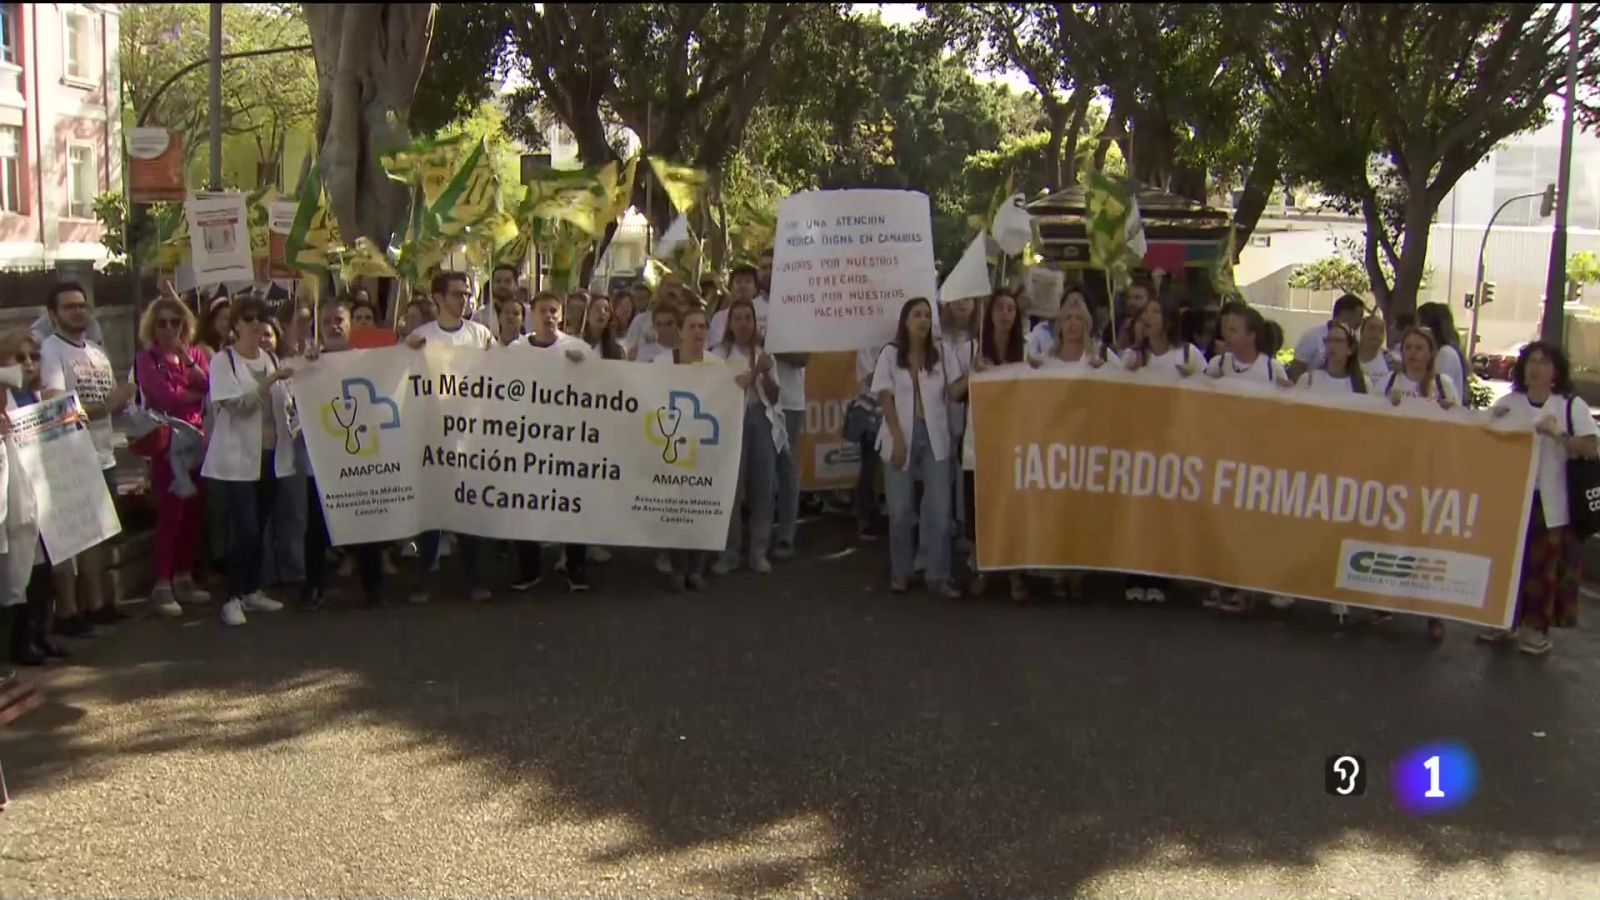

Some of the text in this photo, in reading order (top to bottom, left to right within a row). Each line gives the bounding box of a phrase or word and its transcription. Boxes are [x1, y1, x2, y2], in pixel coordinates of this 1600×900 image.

[821, 233, 853, 246] DIGNA
[860, 234, 873, 244] EN
[781, 293, 815, 304] UNIDOS
[849, 289, 905, 300] NUESTROS
[409, 373, 639, 413] Tu Médic@ luchando
[443, 415, 600, 444] por mejorar la
[340, 462, 400, 478] AMAPCAN
[423, 445, 621, 480] Atención Primaria
[652, 474, 713, 487] AMAPCAN
[1014, 443, 1479, 539] ¡ACUERDOS FIRMADOS YA!
[454, 481, 582, 513] de Canarias
